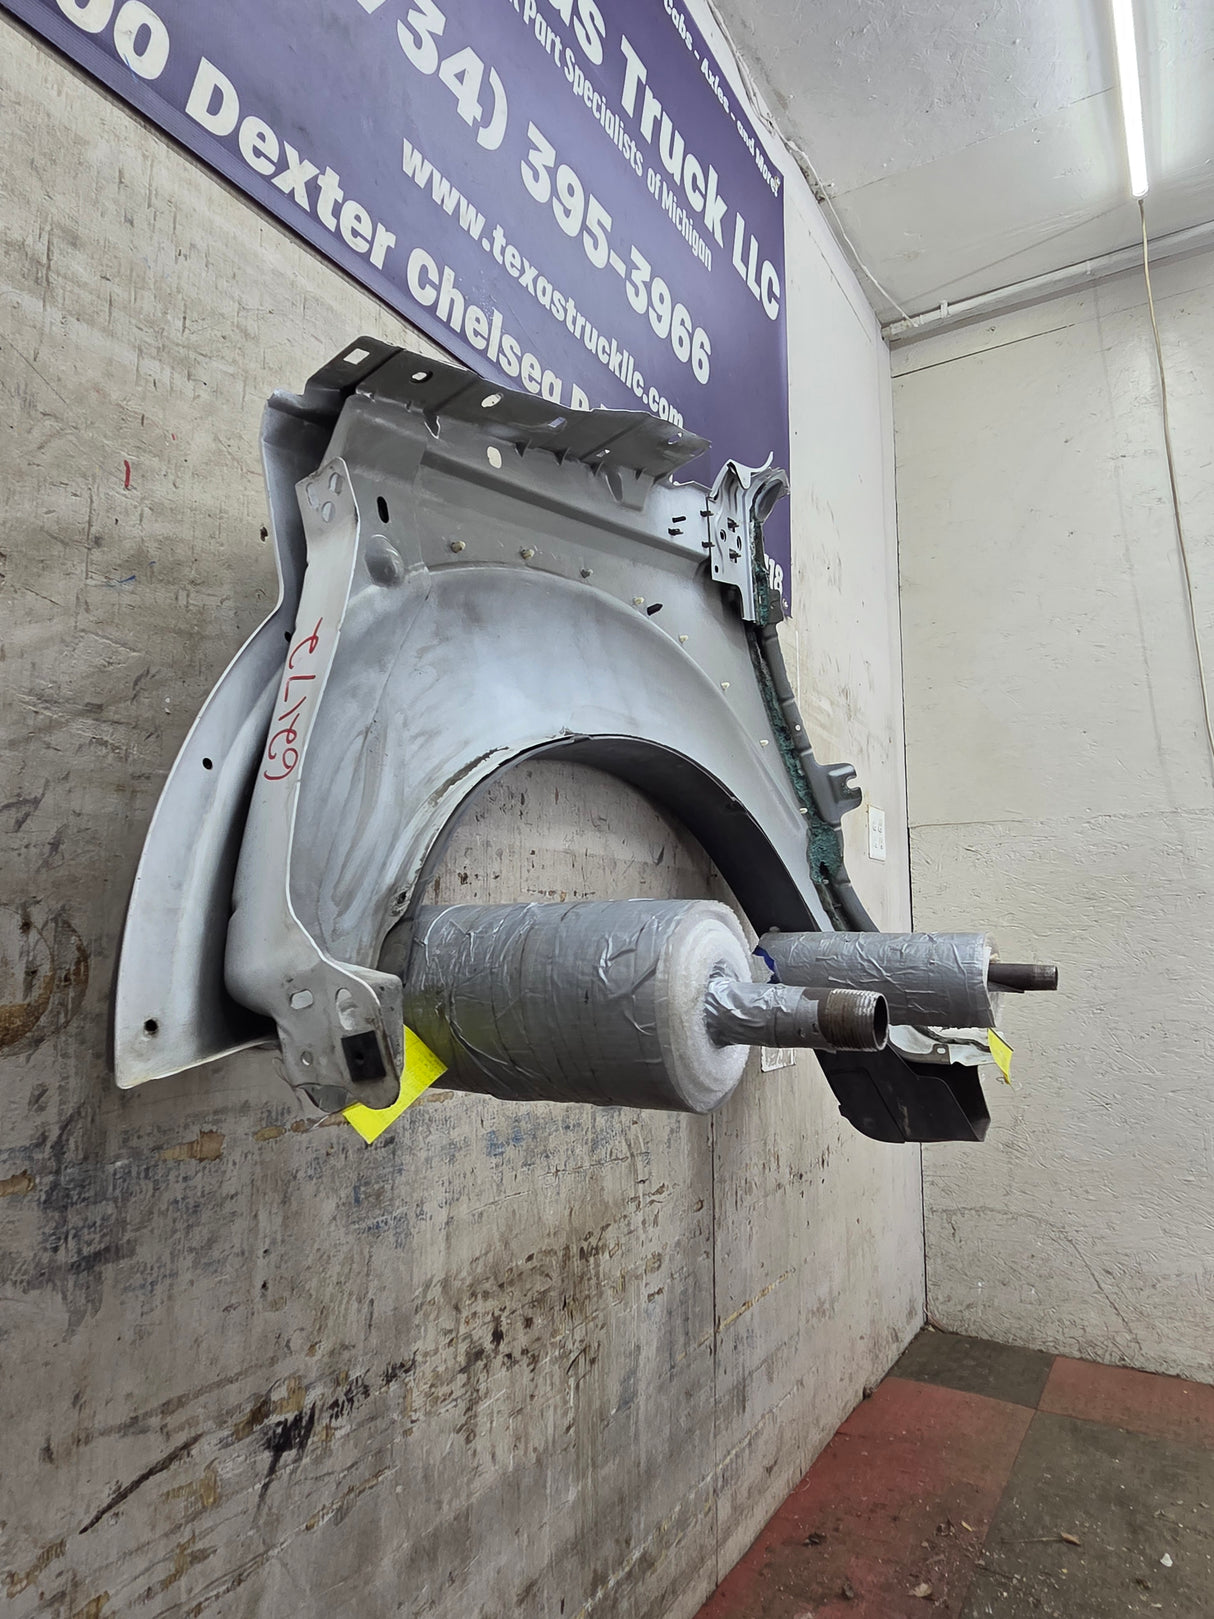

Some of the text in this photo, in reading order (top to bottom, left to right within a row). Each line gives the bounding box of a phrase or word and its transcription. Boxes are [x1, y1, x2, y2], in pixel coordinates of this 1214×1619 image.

[184, 55, 397, 271] Dexter
[406, 247, 563, 405] Chelsea
[356, 0, 712, 385] 34) 395-3966
[563, 47, 644, 177] Specialists
[646, 167, 662, 201] of
[661, 181, 713, 273] Michigan
[620, 33, 728, 249] Truck
[732, 211, 781, 321] LLC
[700, 57, 730, 114] Axles
[736, 120, 755, 156] and
[402, 137, 685, 430] www.texastruckllc.com
